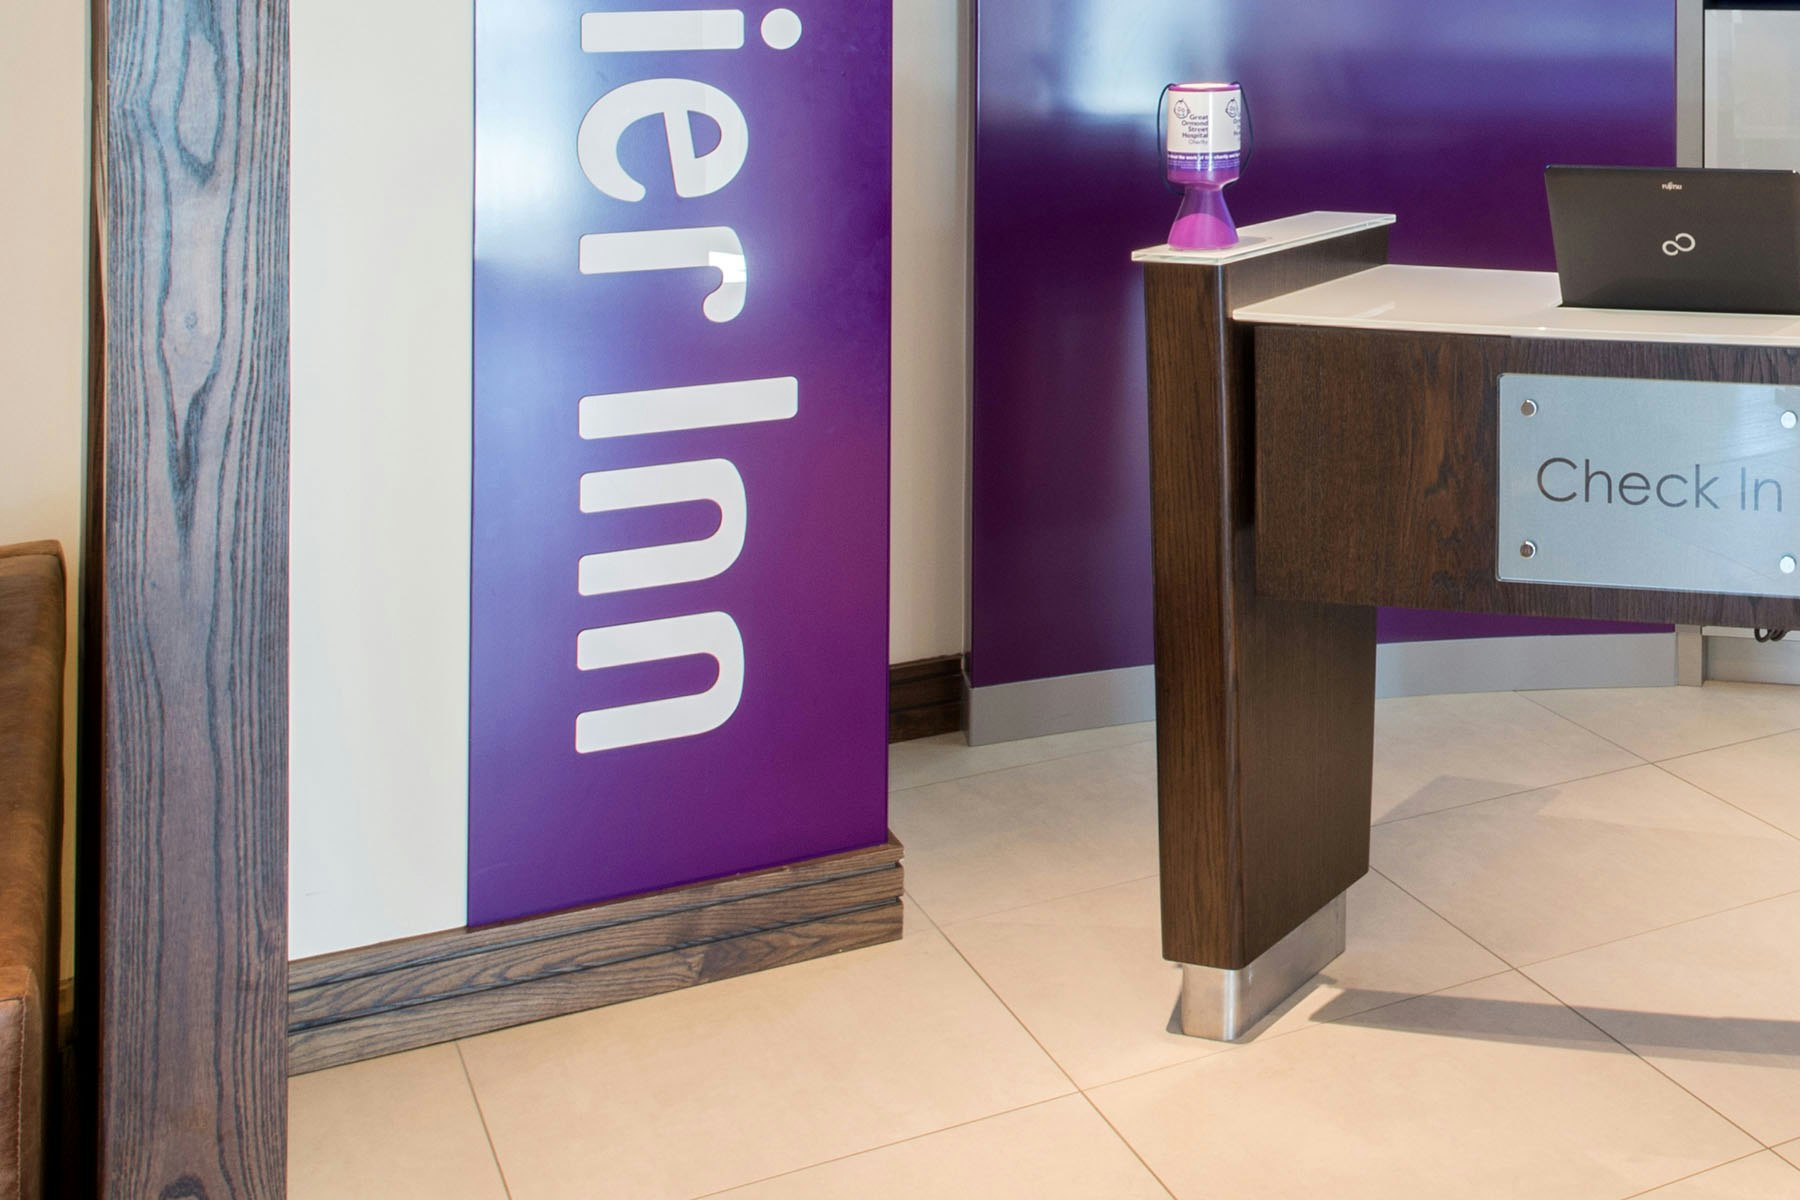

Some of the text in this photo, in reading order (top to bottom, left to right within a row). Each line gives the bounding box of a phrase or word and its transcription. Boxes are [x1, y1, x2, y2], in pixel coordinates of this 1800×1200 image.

[575, 376, 799, 754] Inn
[1537, 457, 1783, 512] Check In
